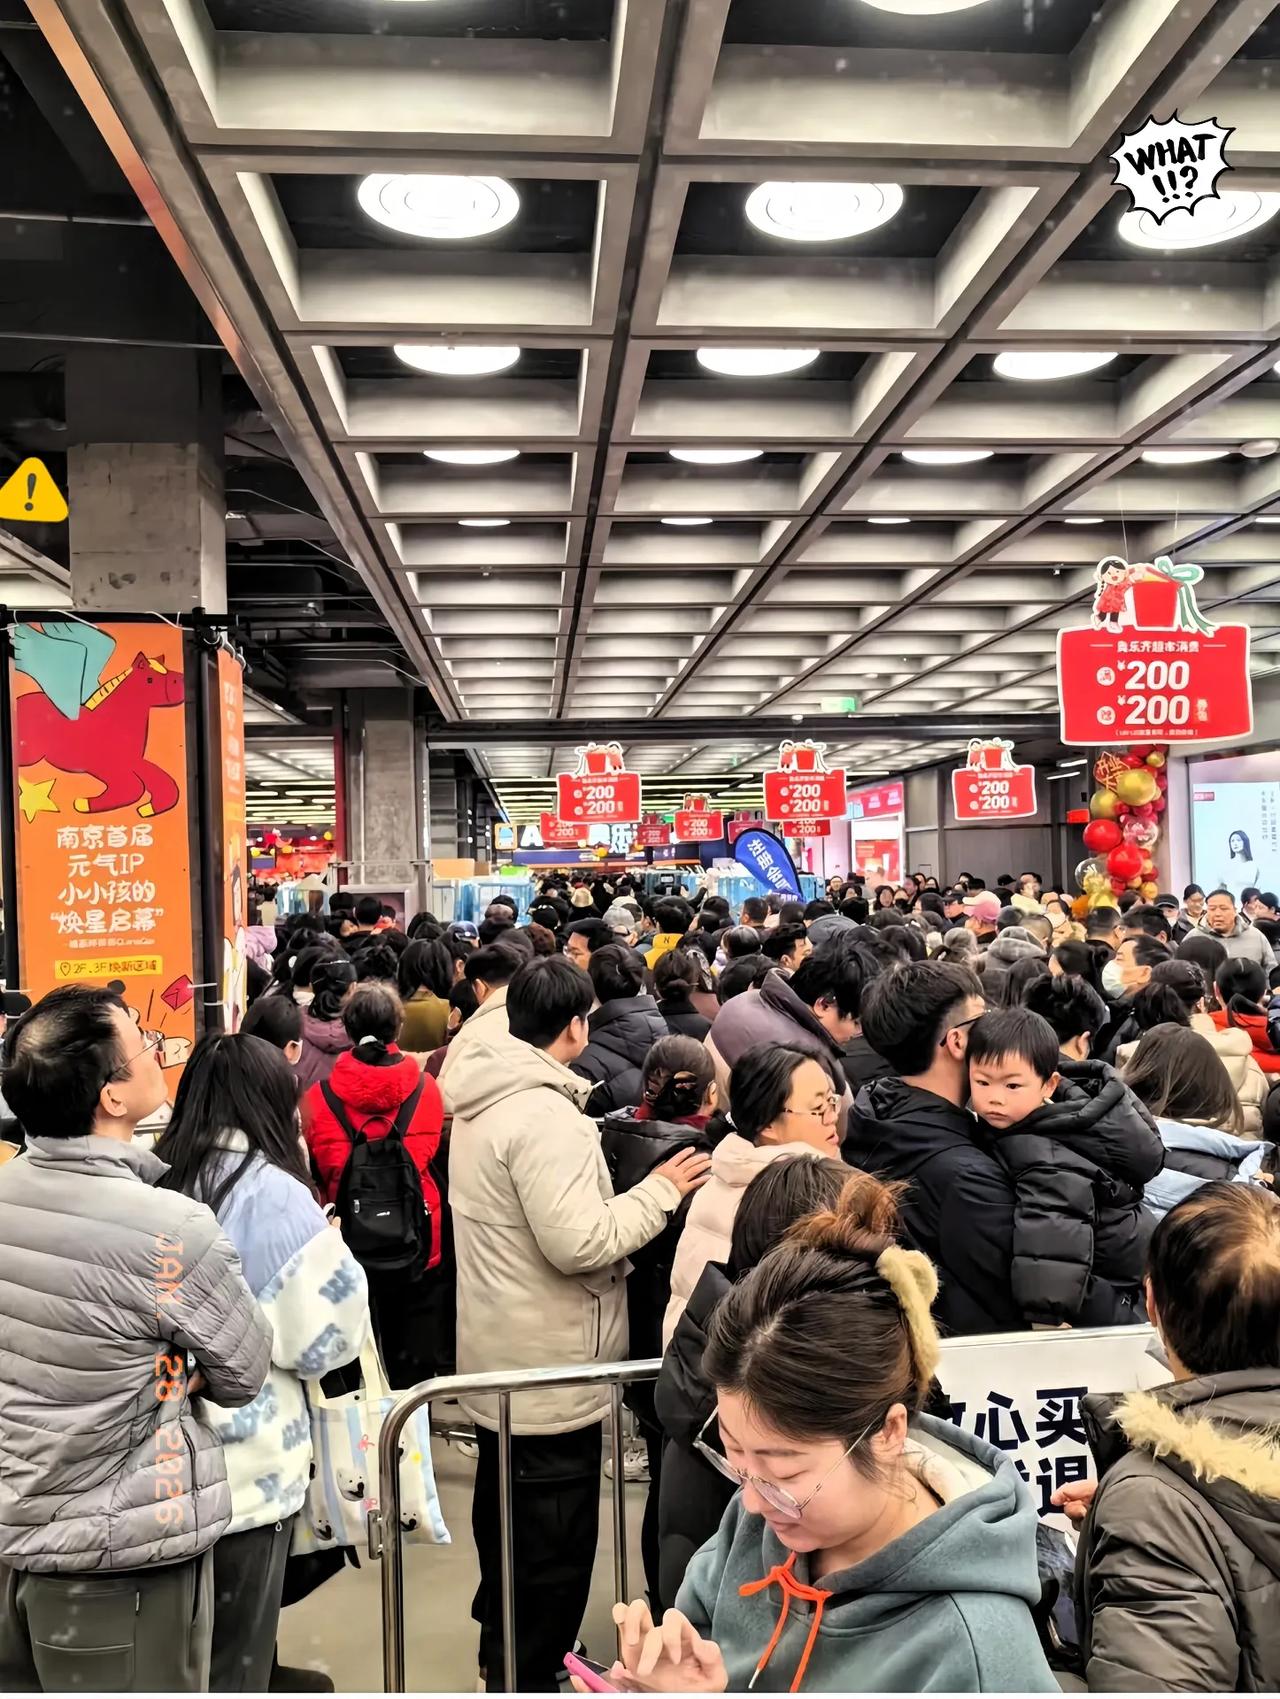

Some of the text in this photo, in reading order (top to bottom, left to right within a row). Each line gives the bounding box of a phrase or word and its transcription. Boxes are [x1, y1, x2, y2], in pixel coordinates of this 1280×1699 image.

[56, 824, 153, 849] 南京首届
[67, 853, 144, 878] 元气IP
[58, 879, 156, 905] 小小孩的
[945, 1387, 1088, 1450] 心买
